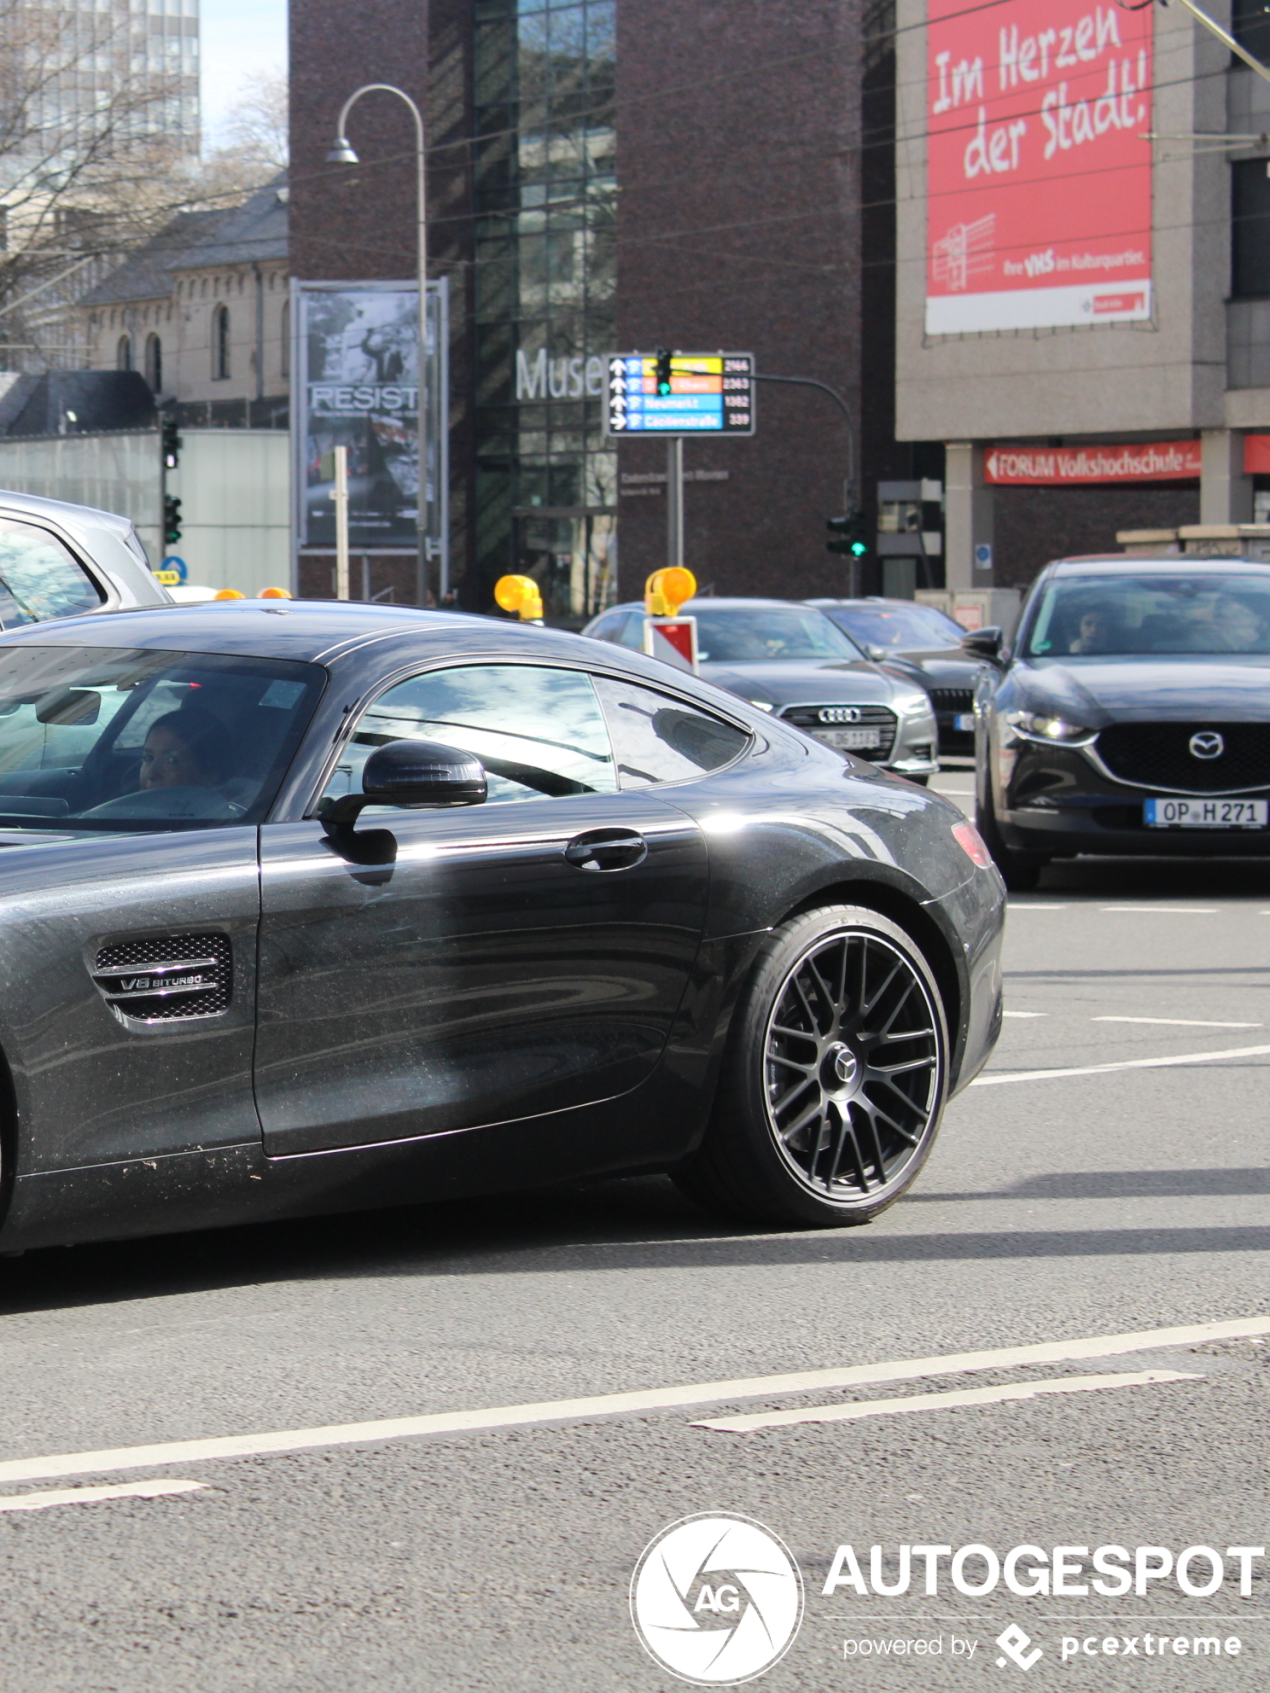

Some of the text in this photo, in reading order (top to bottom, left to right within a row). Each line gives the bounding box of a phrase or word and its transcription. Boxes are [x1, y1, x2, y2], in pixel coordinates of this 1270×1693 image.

[933, 6, 1121, 115] Im Herzen
[964, 48, 1147, 179] der Stadt!
[1024, 248, 1055, 278] VHS
[516, 348, 603, 400] Muse
[644, 397, 699, 409] Neumarkt
[999, 454, 1055, 477] FORUM
[1057, 447, 1184, 477] Volkshochschule
[1164, 802, 1257, 822] OP H 271
[121, 975, 202, 990] V8 BITURBO
